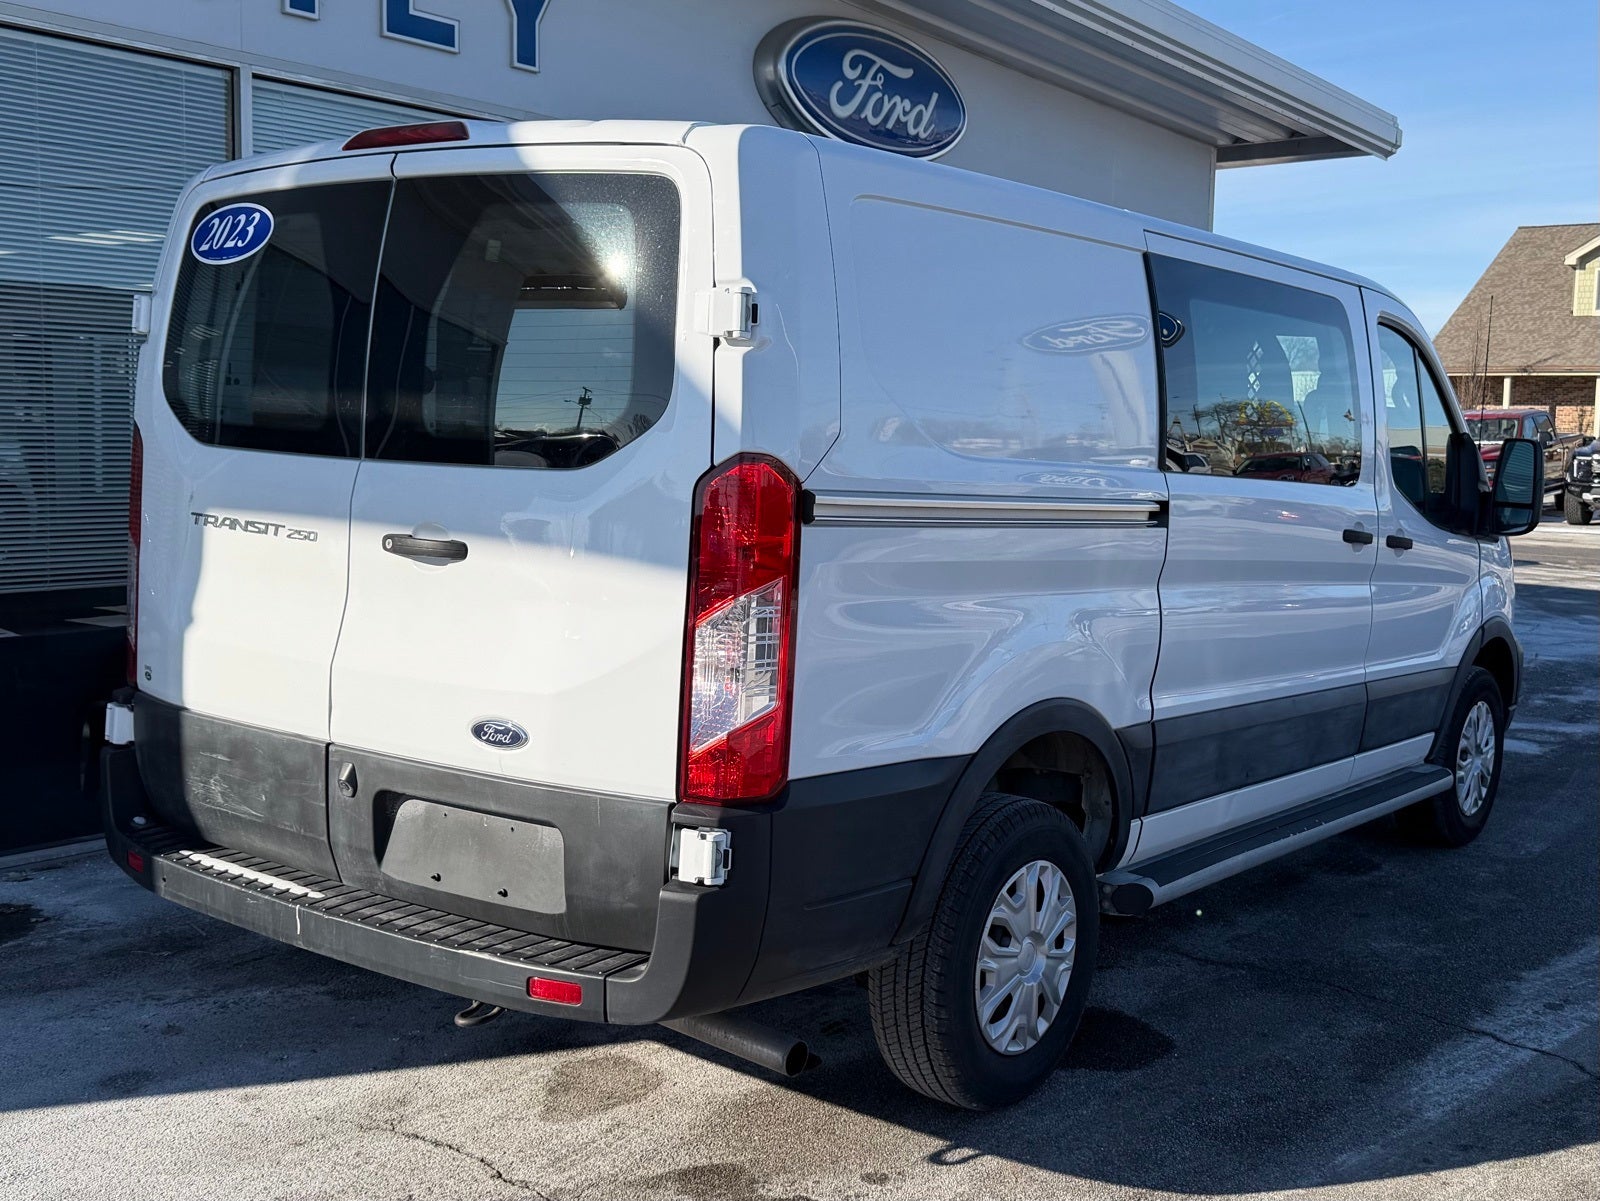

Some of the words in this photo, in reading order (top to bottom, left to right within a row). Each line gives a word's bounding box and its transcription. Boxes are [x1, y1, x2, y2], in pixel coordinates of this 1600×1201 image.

[829, 49, 939, 139] Ford
[199, 211, 261, 252] 2023
[190, 511, 286, 537] TRANSIT
[286, 528, 319, 542] 250
[480, 723, 513, 744] Ford
